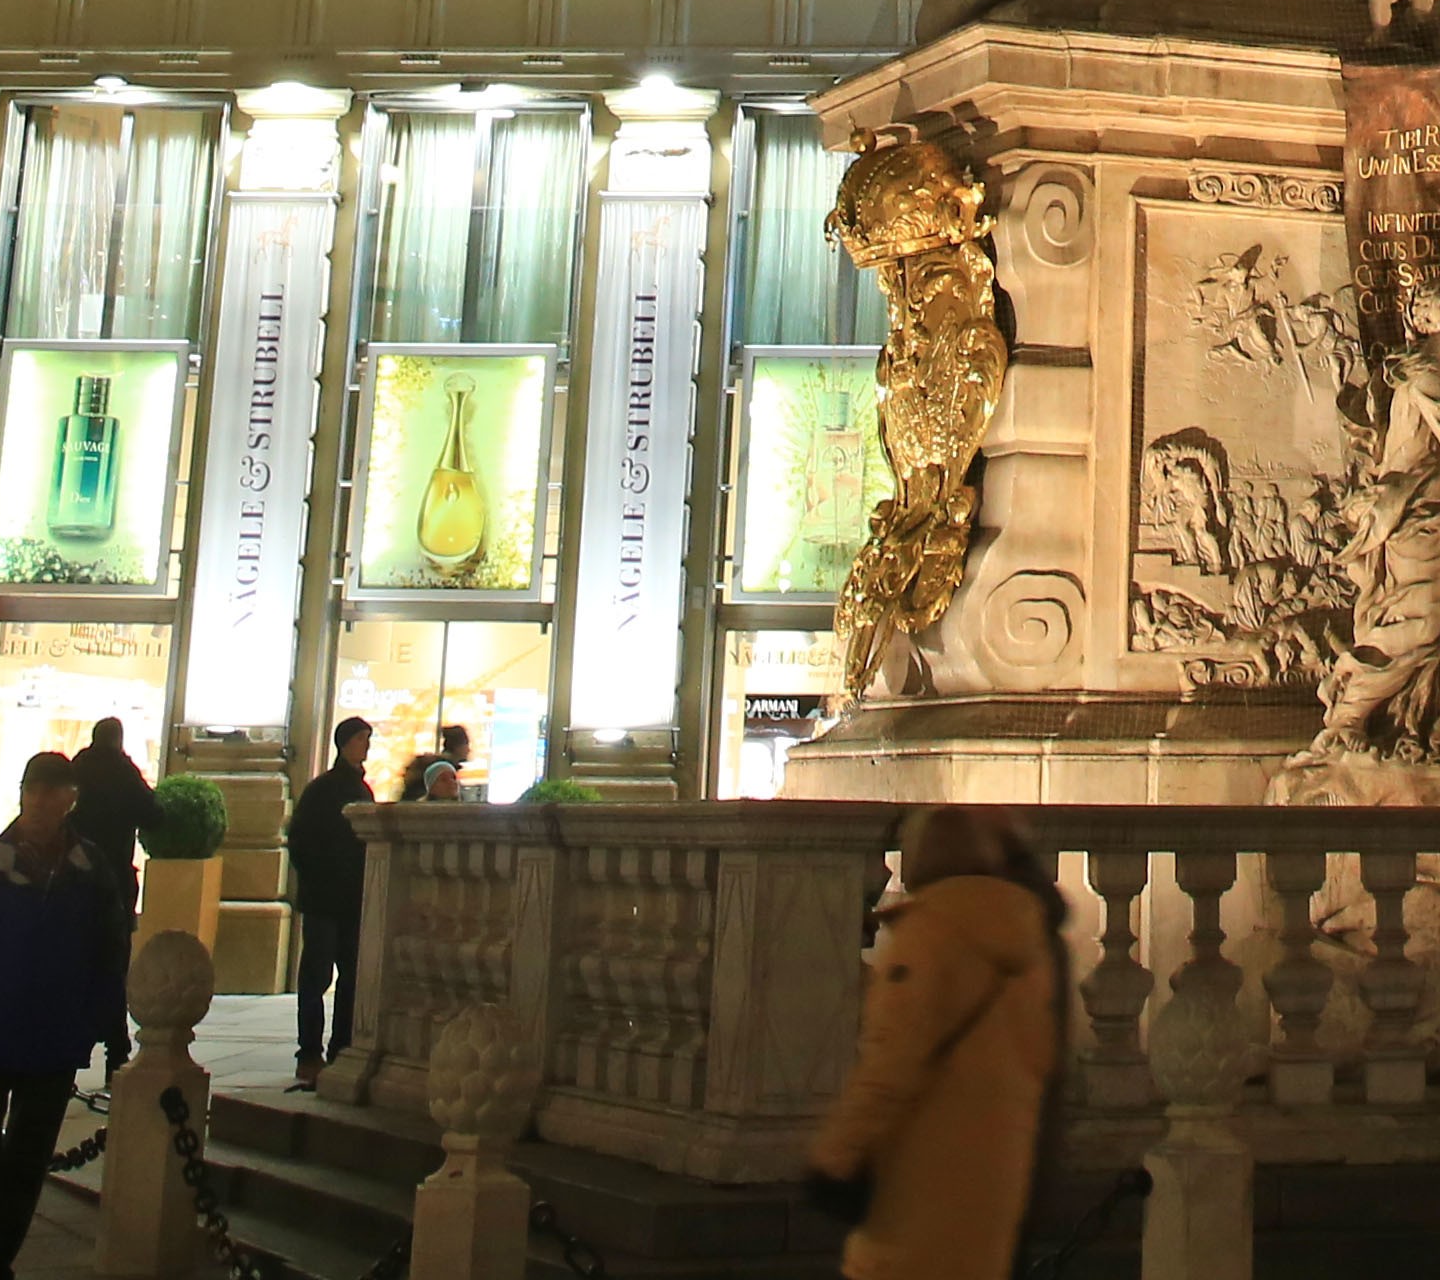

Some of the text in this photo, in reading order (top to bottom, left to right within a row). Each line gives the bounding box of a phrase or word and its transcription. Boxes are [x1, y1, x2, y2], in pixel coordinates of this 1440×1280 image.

[1378, 128, 1422, 150] TIBI
[239, 454, 272, 493] &
[620, 456, 651, 495] &
[752, 698, 799, 713] ARMANI
